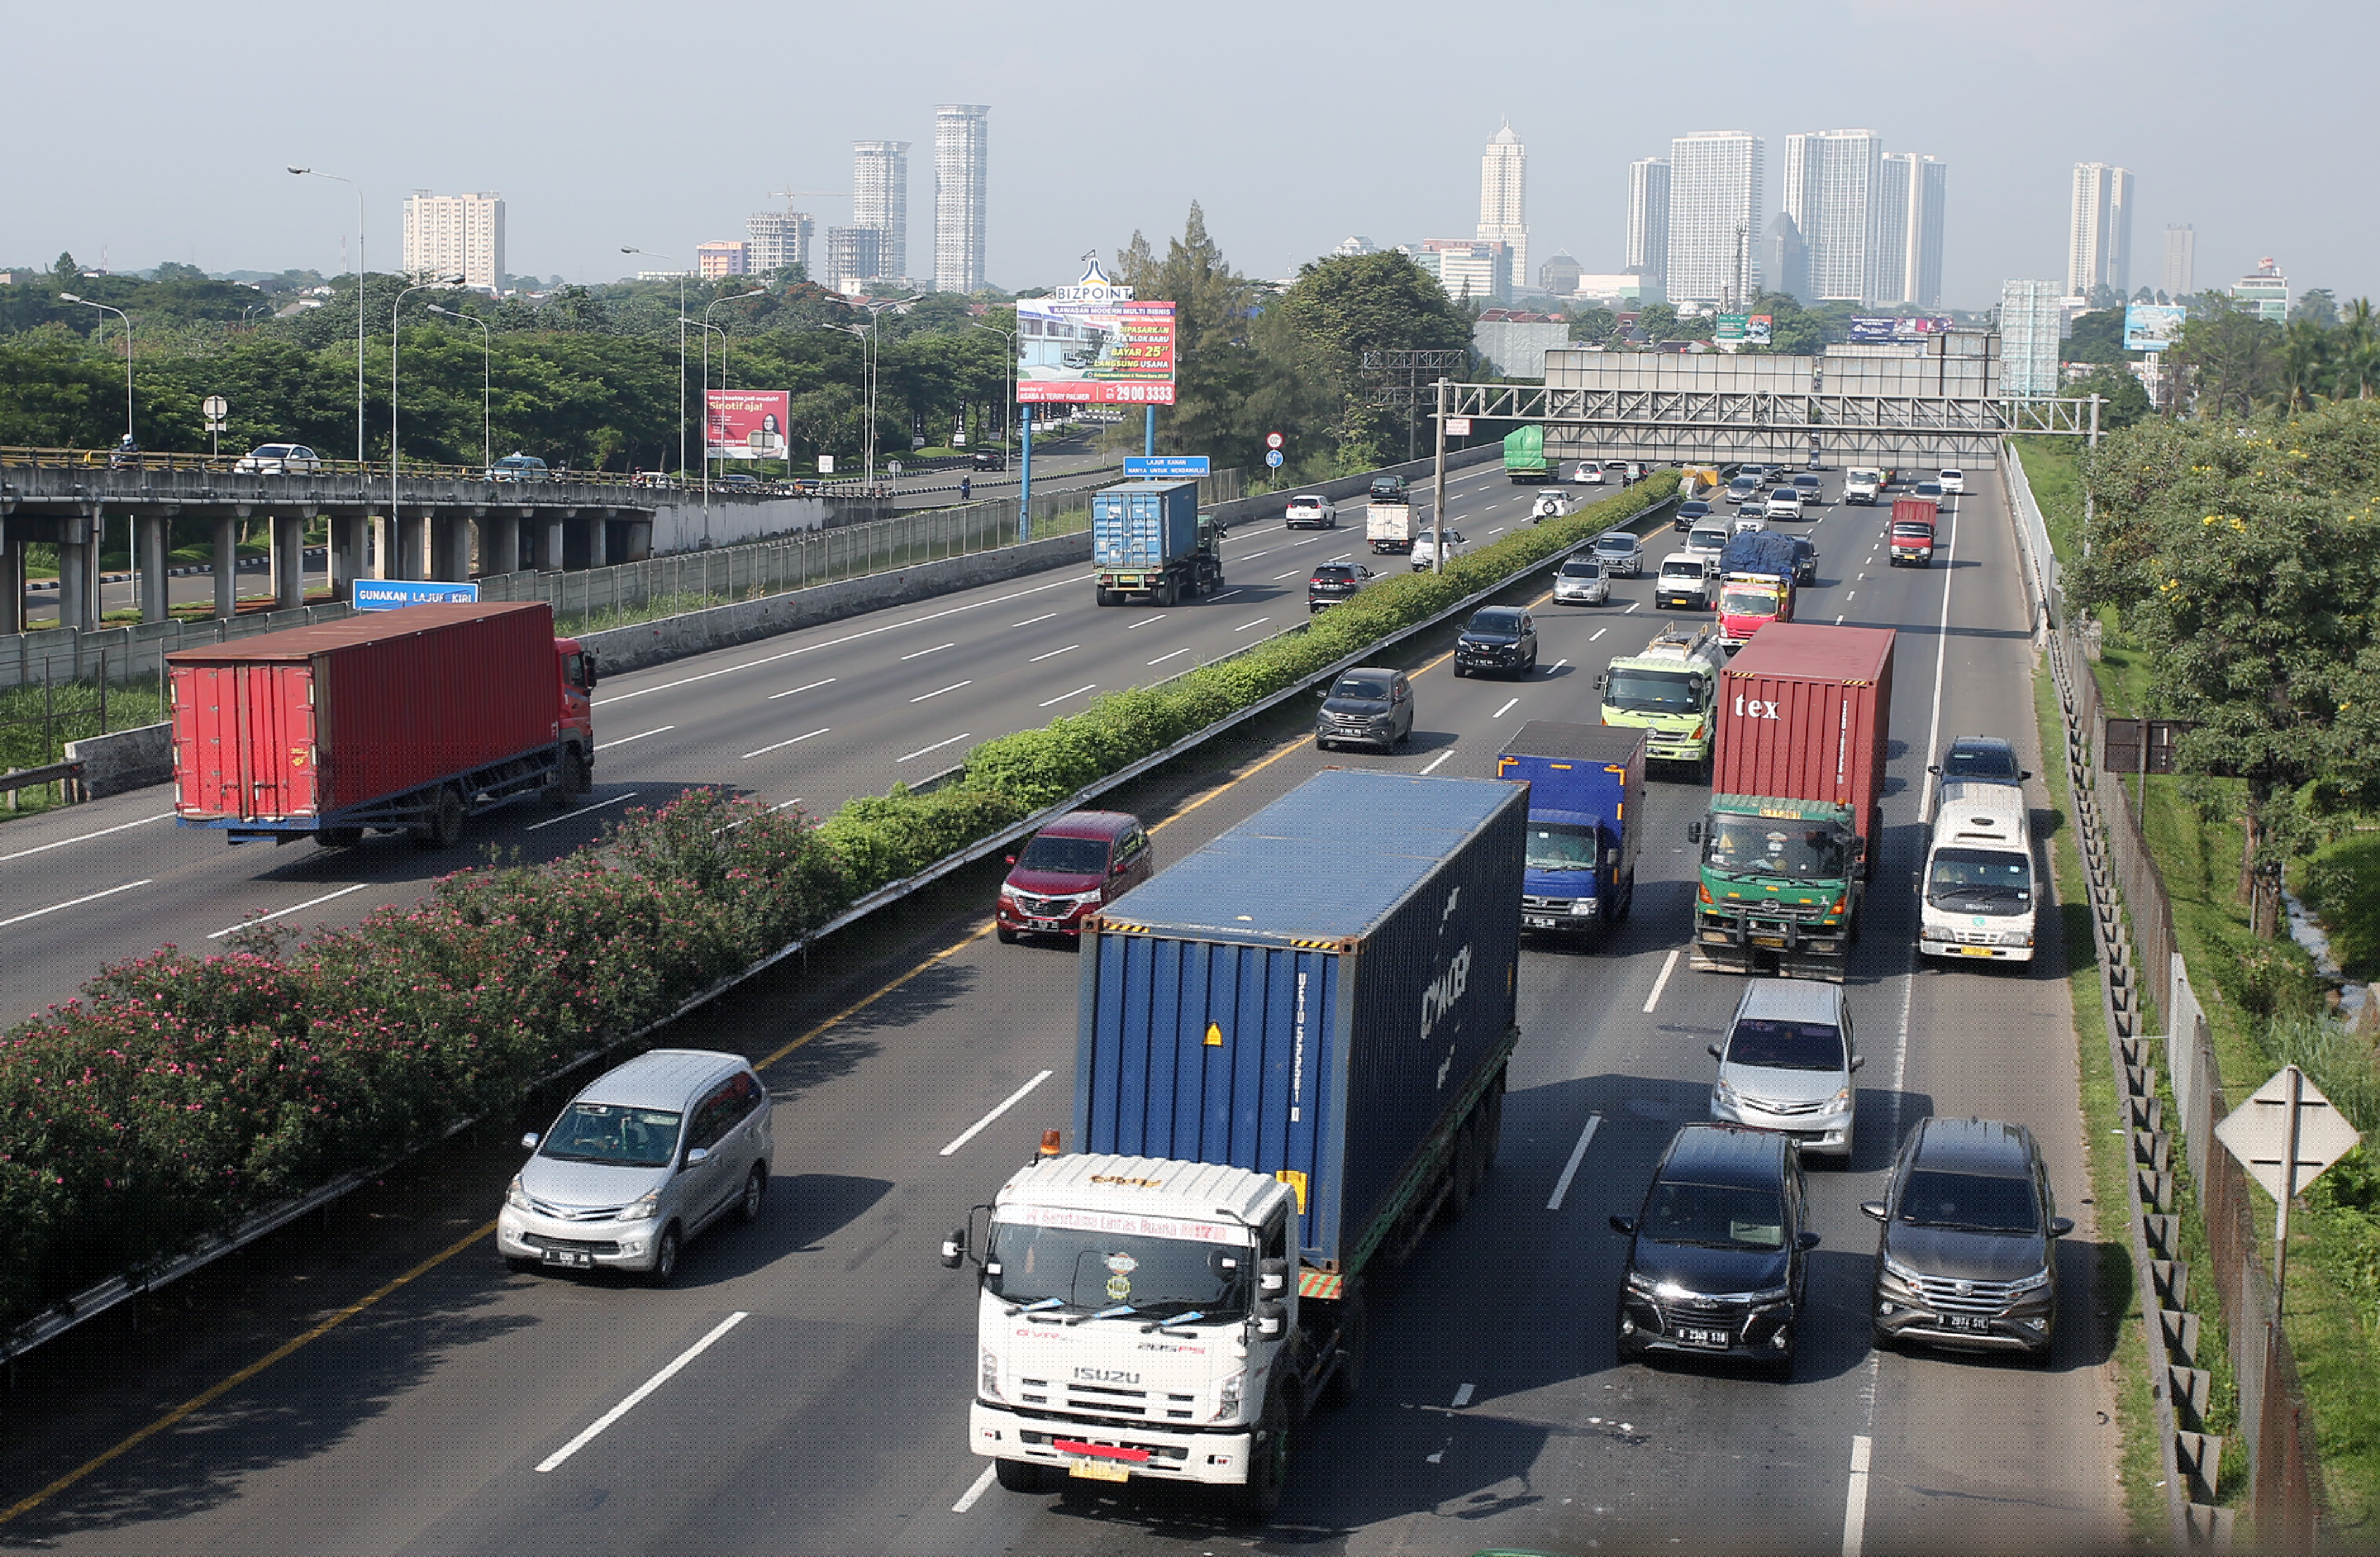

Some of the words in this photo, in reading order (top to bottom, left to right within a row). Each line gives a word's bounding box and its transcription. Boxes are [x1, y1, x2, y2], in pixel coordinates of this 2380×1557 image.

[1058, 287, 1130, 299] BIZPOINT
[1111, 348, 1142, 356] BAYAR
[1094, 359, 1139, 368] LANGSUNG
[1117, 386, 1130, 401] 29
[1131, 386, 1145, 401] 00
[1146, 386, 1172, 401] 3333
[744, 402, 763, 412] aja!
[1268, 453, 1277, 464] 60
[359, 590, 407, 602] GUNAKAN
[452, 593, 472, 603] KIRI
[1735, 693, 1780, 719] tex
[1101, 1215, 1136, 1232] Lintas
[1140, 1218, 1177, 1236] Buana
[1073, 1366, 1141, 1384] ISUZU
